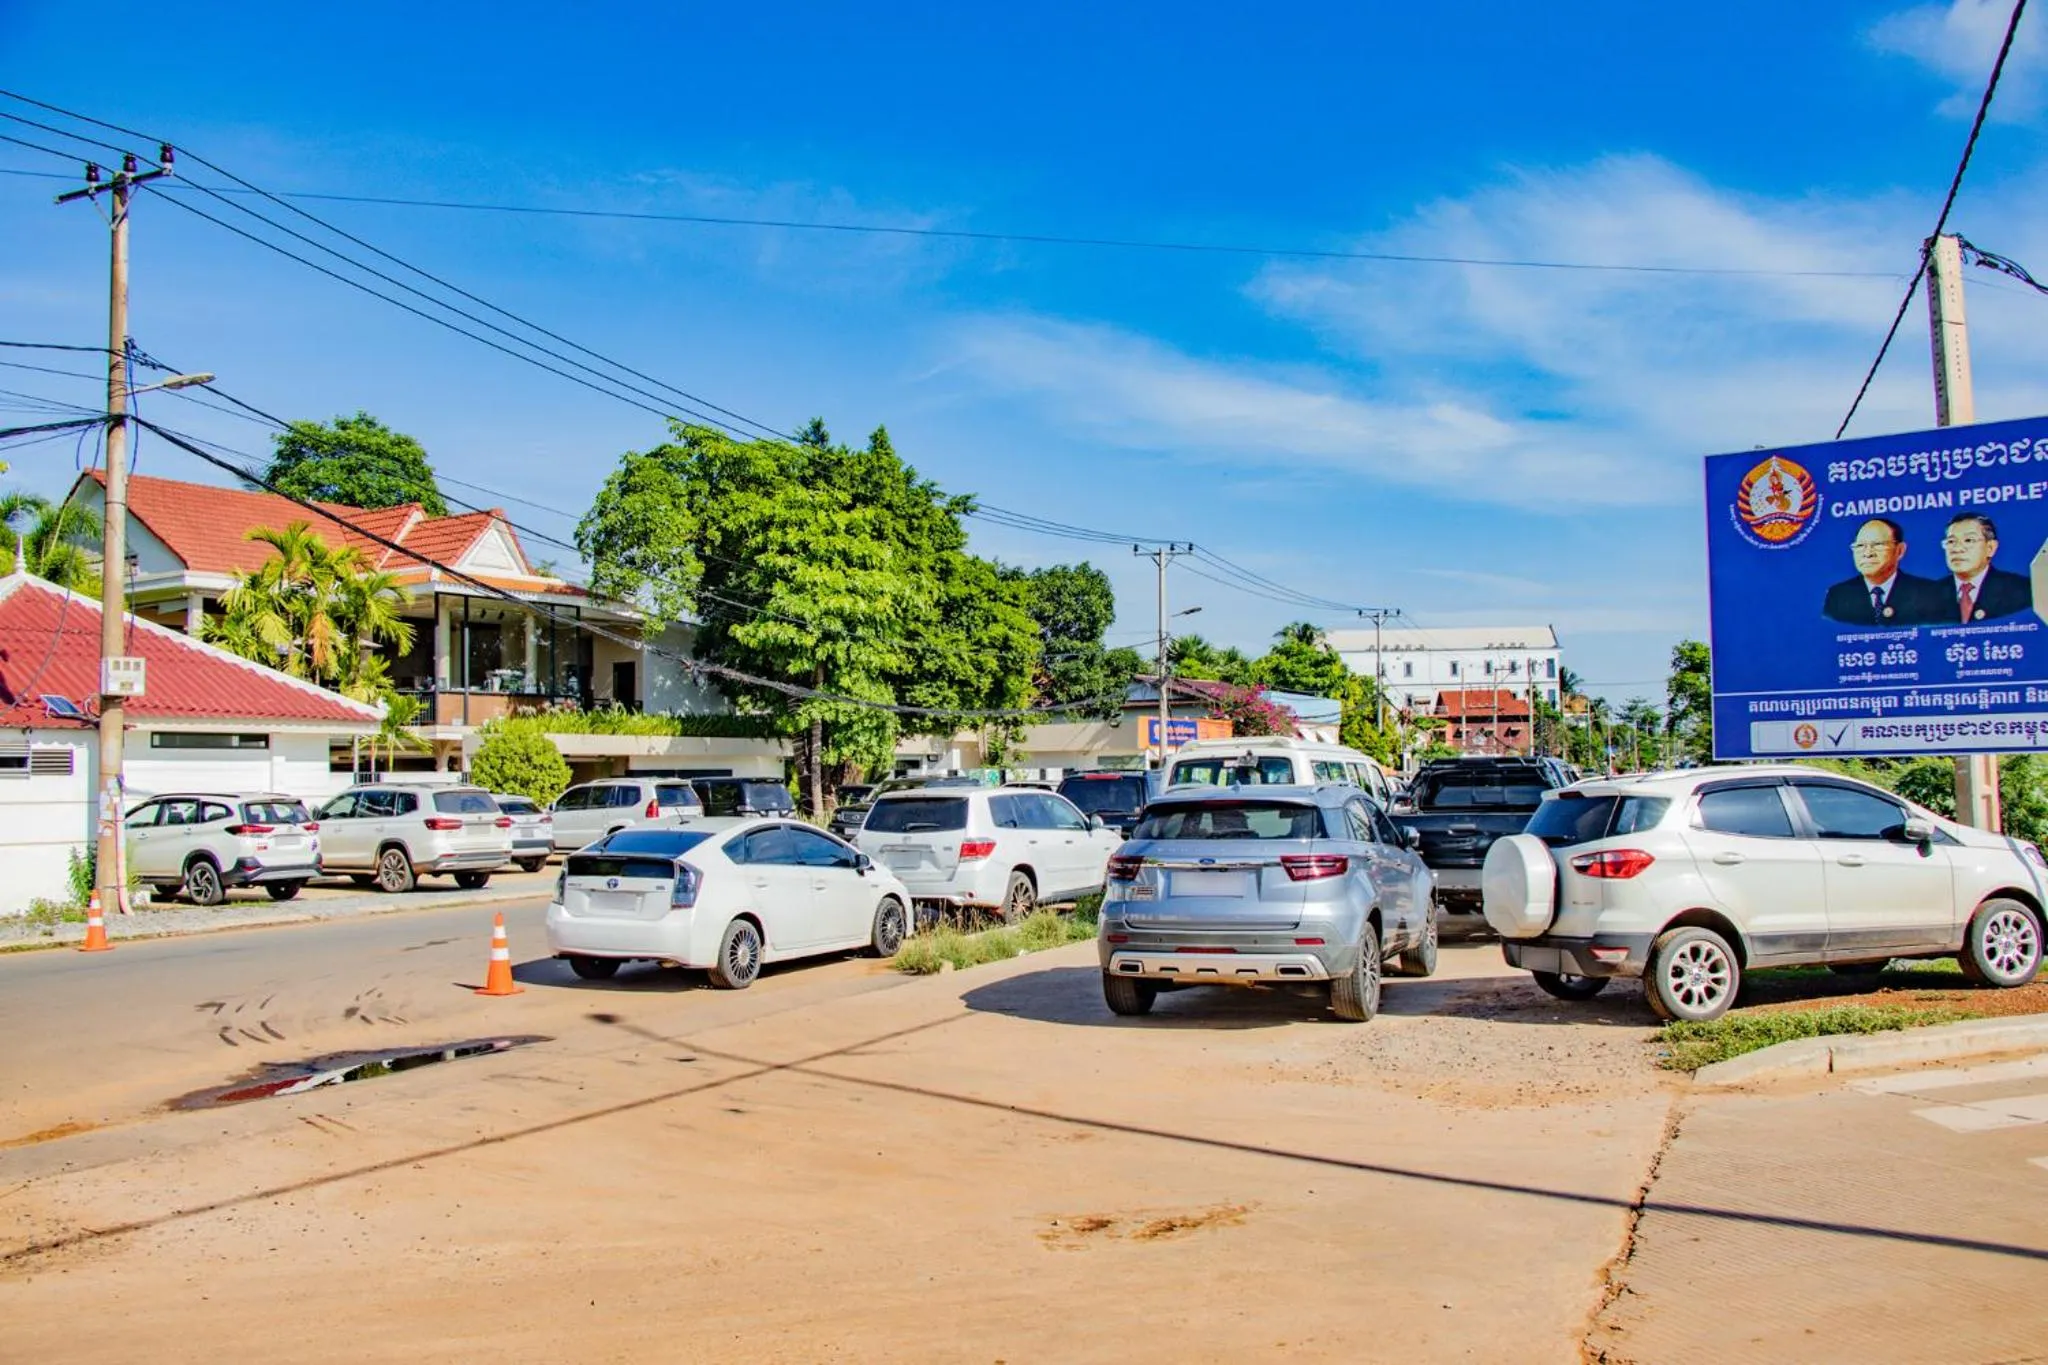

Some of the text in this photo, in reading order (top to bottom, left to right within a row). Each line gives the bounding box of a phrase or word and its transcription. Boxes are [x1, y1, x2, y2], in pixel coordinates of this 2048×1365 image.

[1831, 491, 1953, 518] CAMBODIAN
[1838, 652, 1876, 668] ហេង
[1945, 640, 2024, 668] ហ៊ុន សែន
[1748, 695, 1898, 717] គណបក្សប្រជាជនកម្ពុជា
